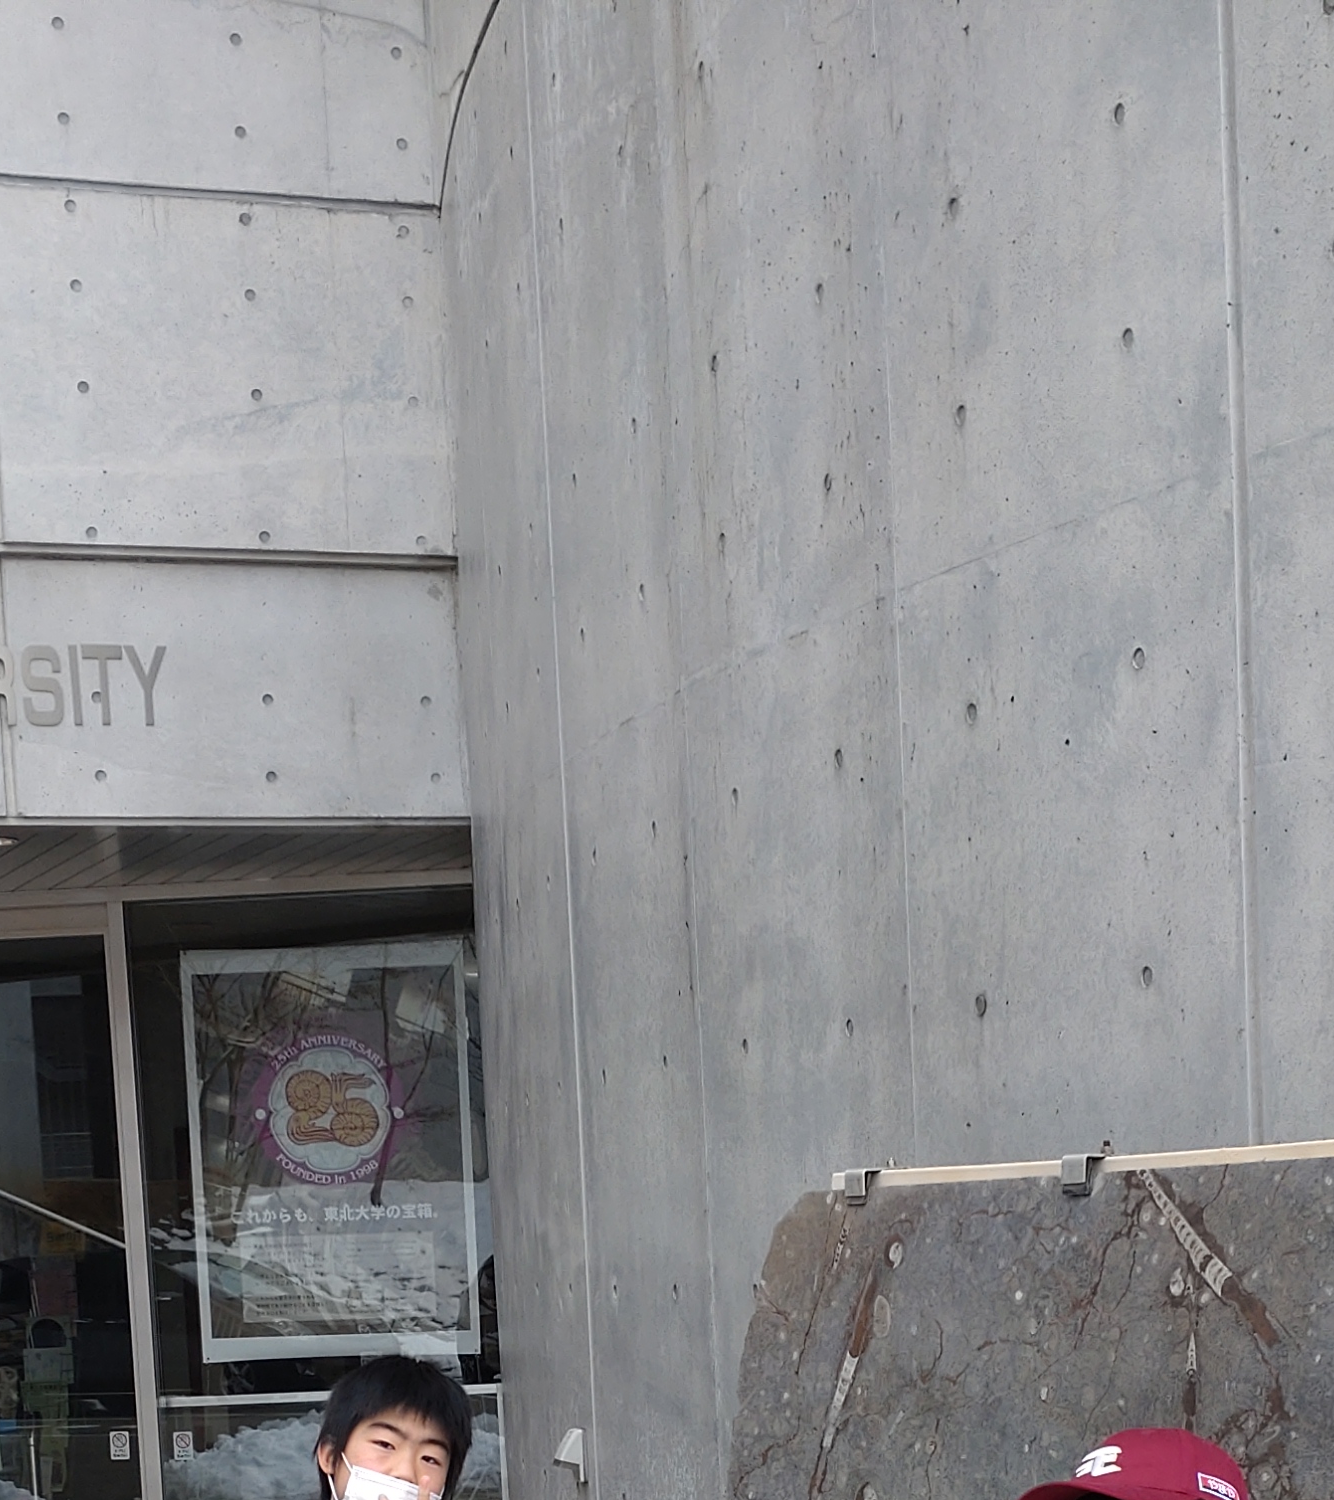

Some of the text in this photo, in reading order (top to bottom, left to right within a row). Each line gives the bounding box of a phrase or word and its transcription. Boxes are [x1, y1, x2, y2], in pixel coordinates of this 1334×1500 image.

[300, 1034, 388, 1071] ANNIVERSARY
[275, 1153, 332, 1185] FOUNDED
[350, 1159, 379, 1182] 1998
